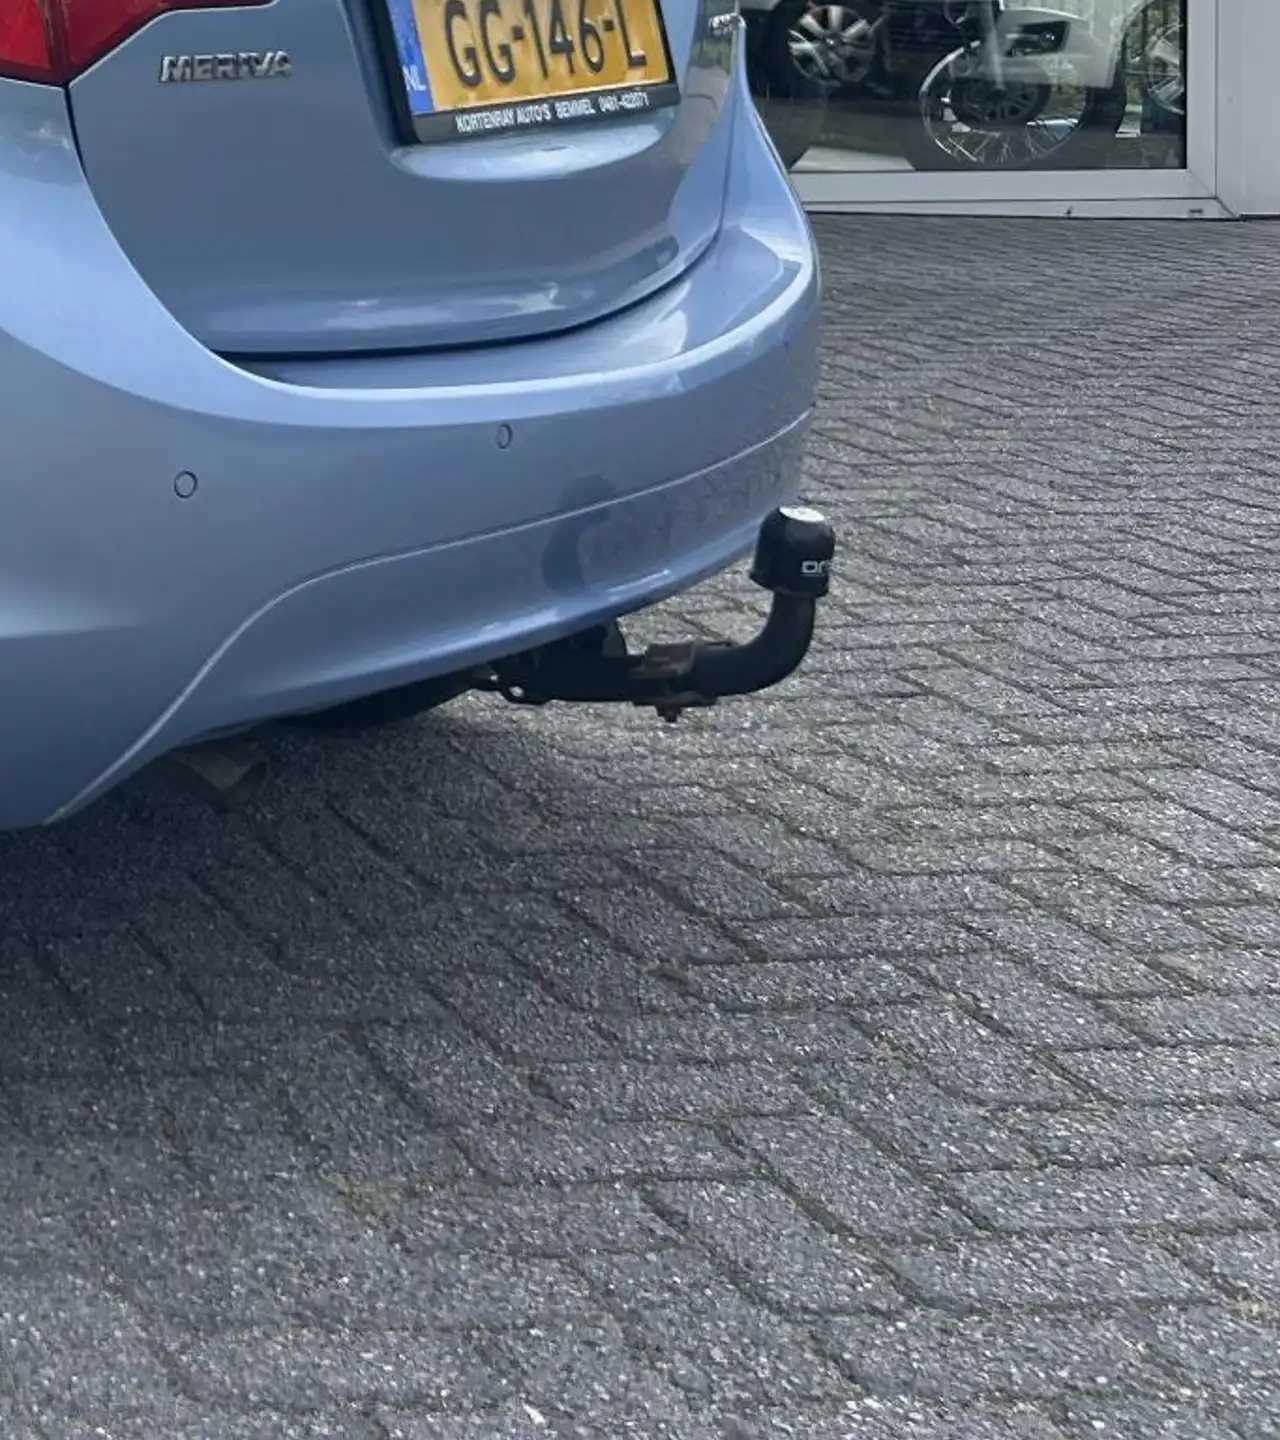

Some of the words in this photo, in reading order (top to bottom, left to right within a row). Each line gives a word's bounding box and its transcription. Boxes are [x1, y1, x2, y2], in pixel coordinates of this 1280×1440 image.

[159, 50, 292, 82] MERIVA
[402, 64, 427, 92] NL
[455, 111, 516, 133] KORTENRAY
